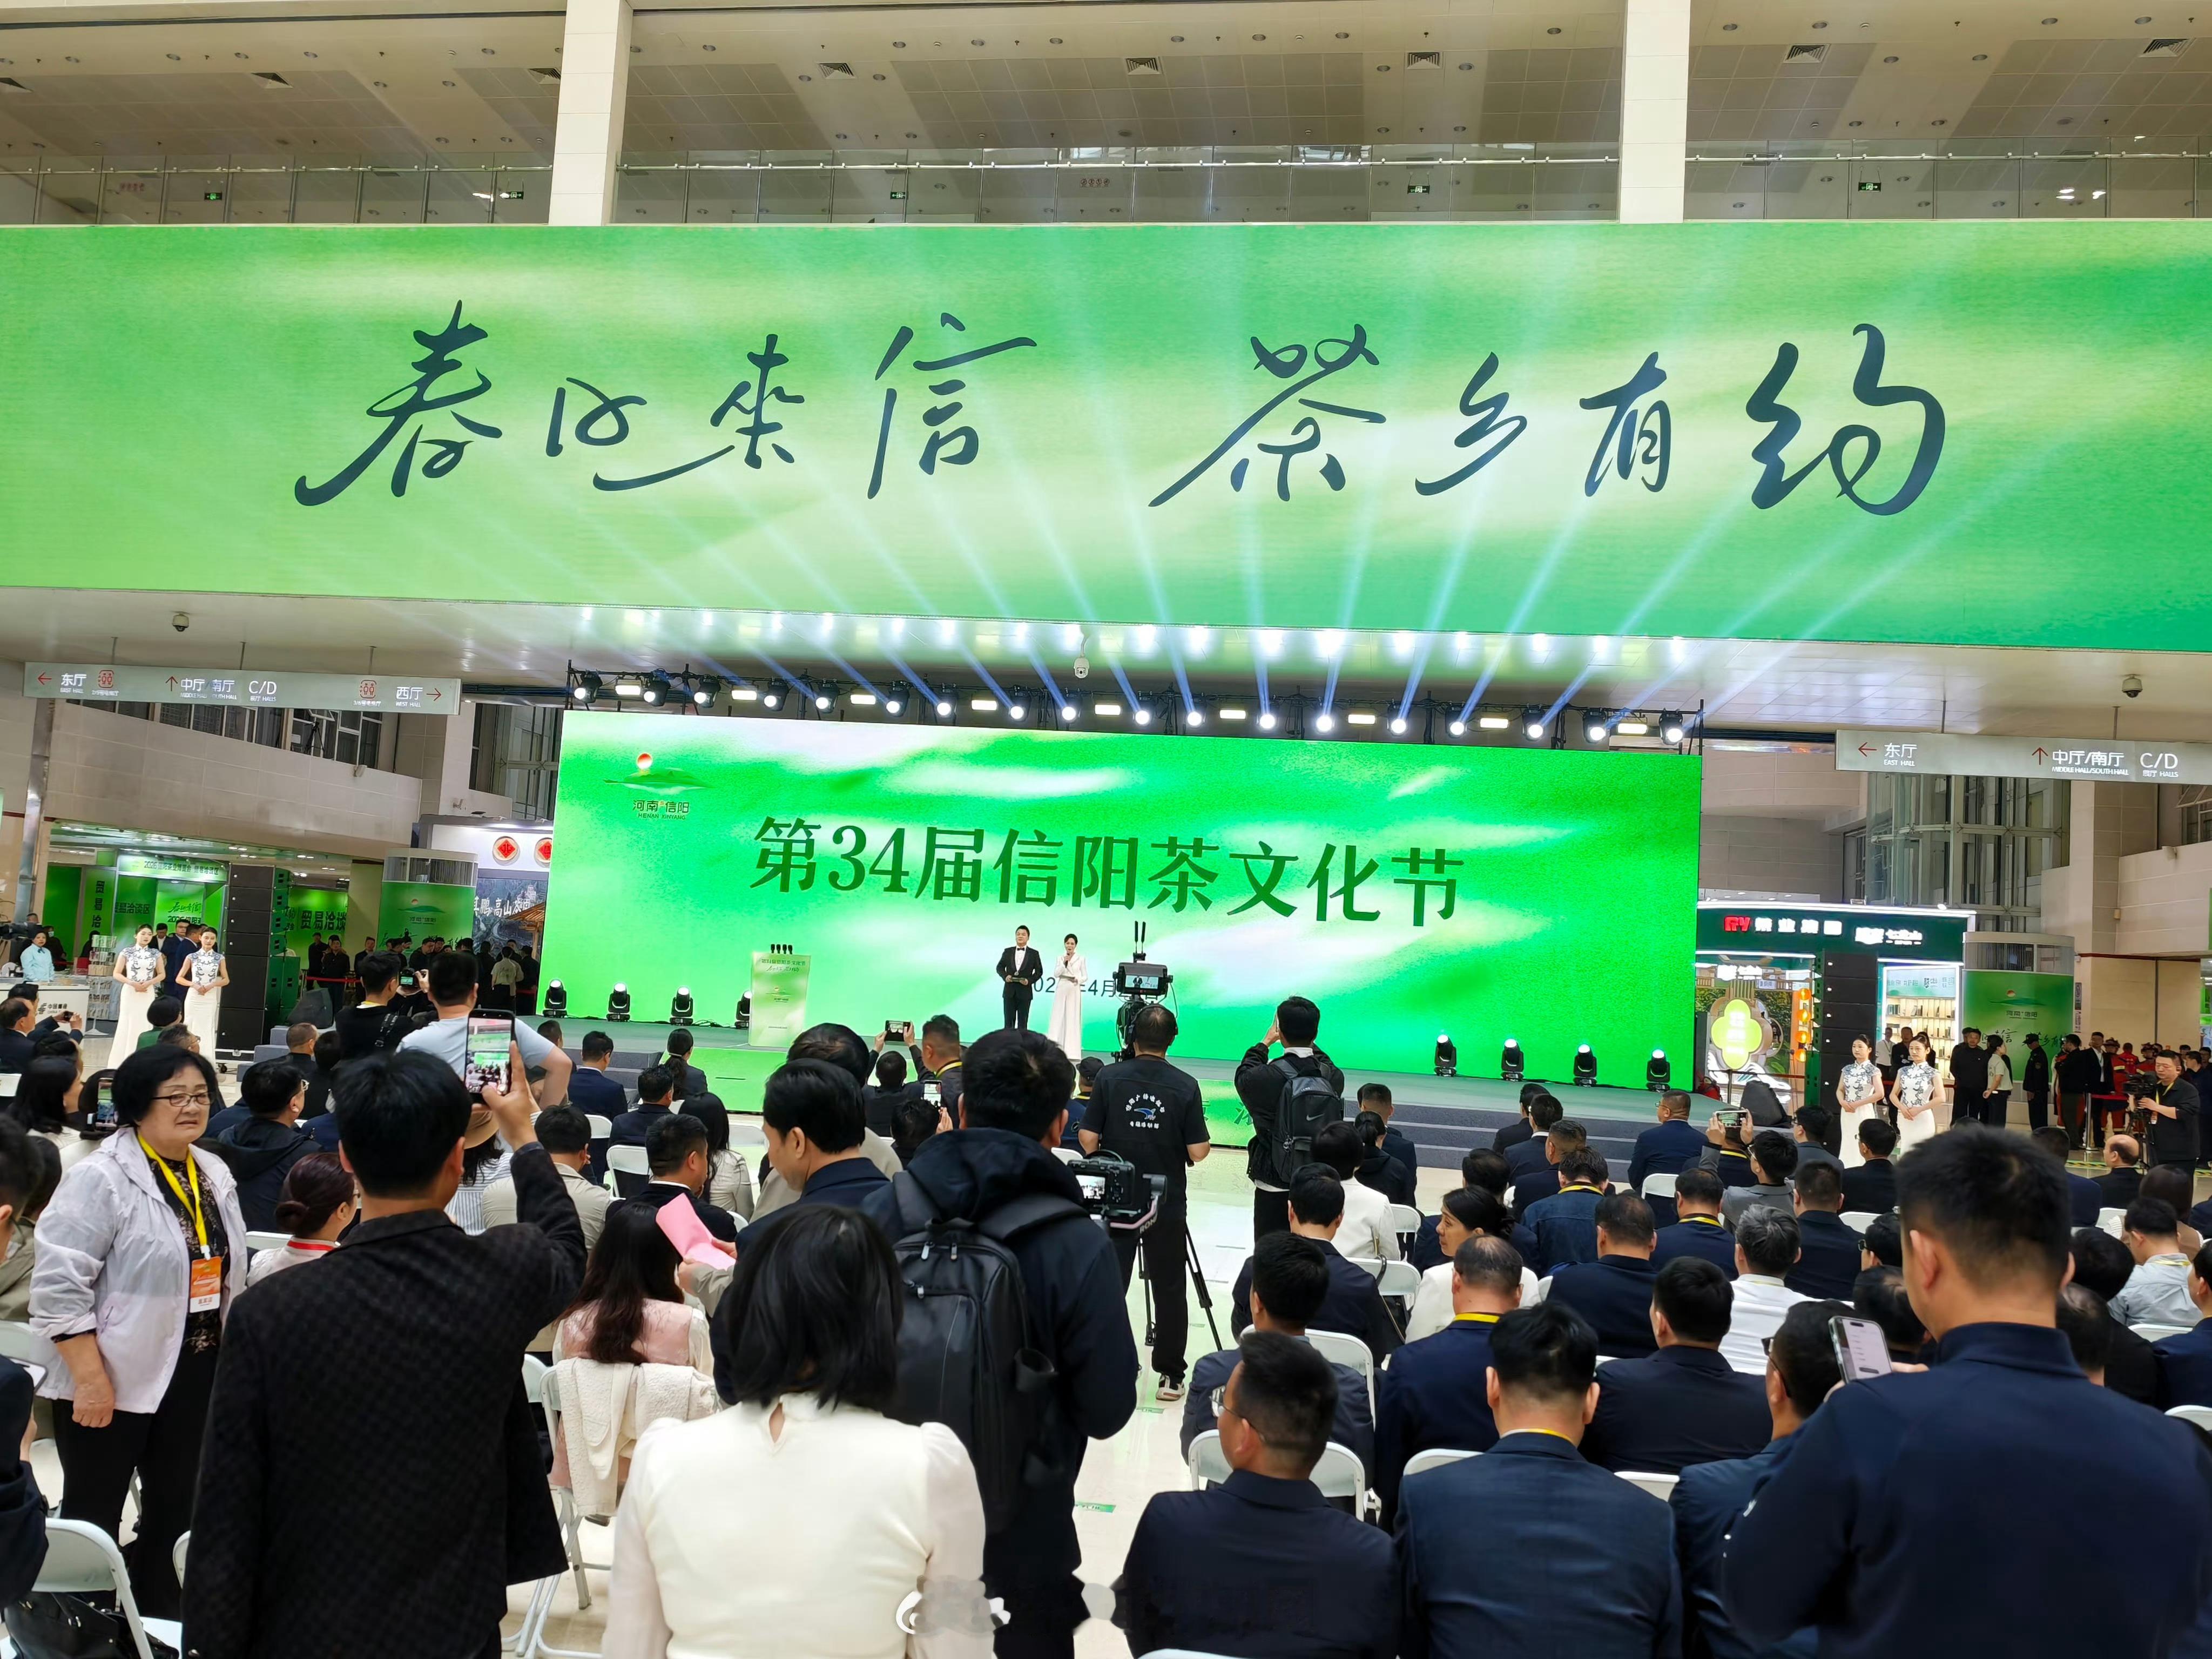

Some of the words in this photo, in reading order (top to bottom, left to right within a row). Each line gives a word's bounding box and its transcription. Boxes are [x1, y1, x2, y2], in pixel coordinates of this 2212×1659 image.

[1148, 323, 1945, 516] 茶乡有约
[60, 673, 87, 686] 东厅
[248, 680, 277, 694] C/D
[396, 686, 423, 700] 西厅
[1884, 743, 1917, 758] 东厅
[2052, 750, 2125, 767] 中厅/南厅
[2140, 752, 2179, 770] C/D
[748, 814, 1466, 928] 第34届信阳茶文化节
